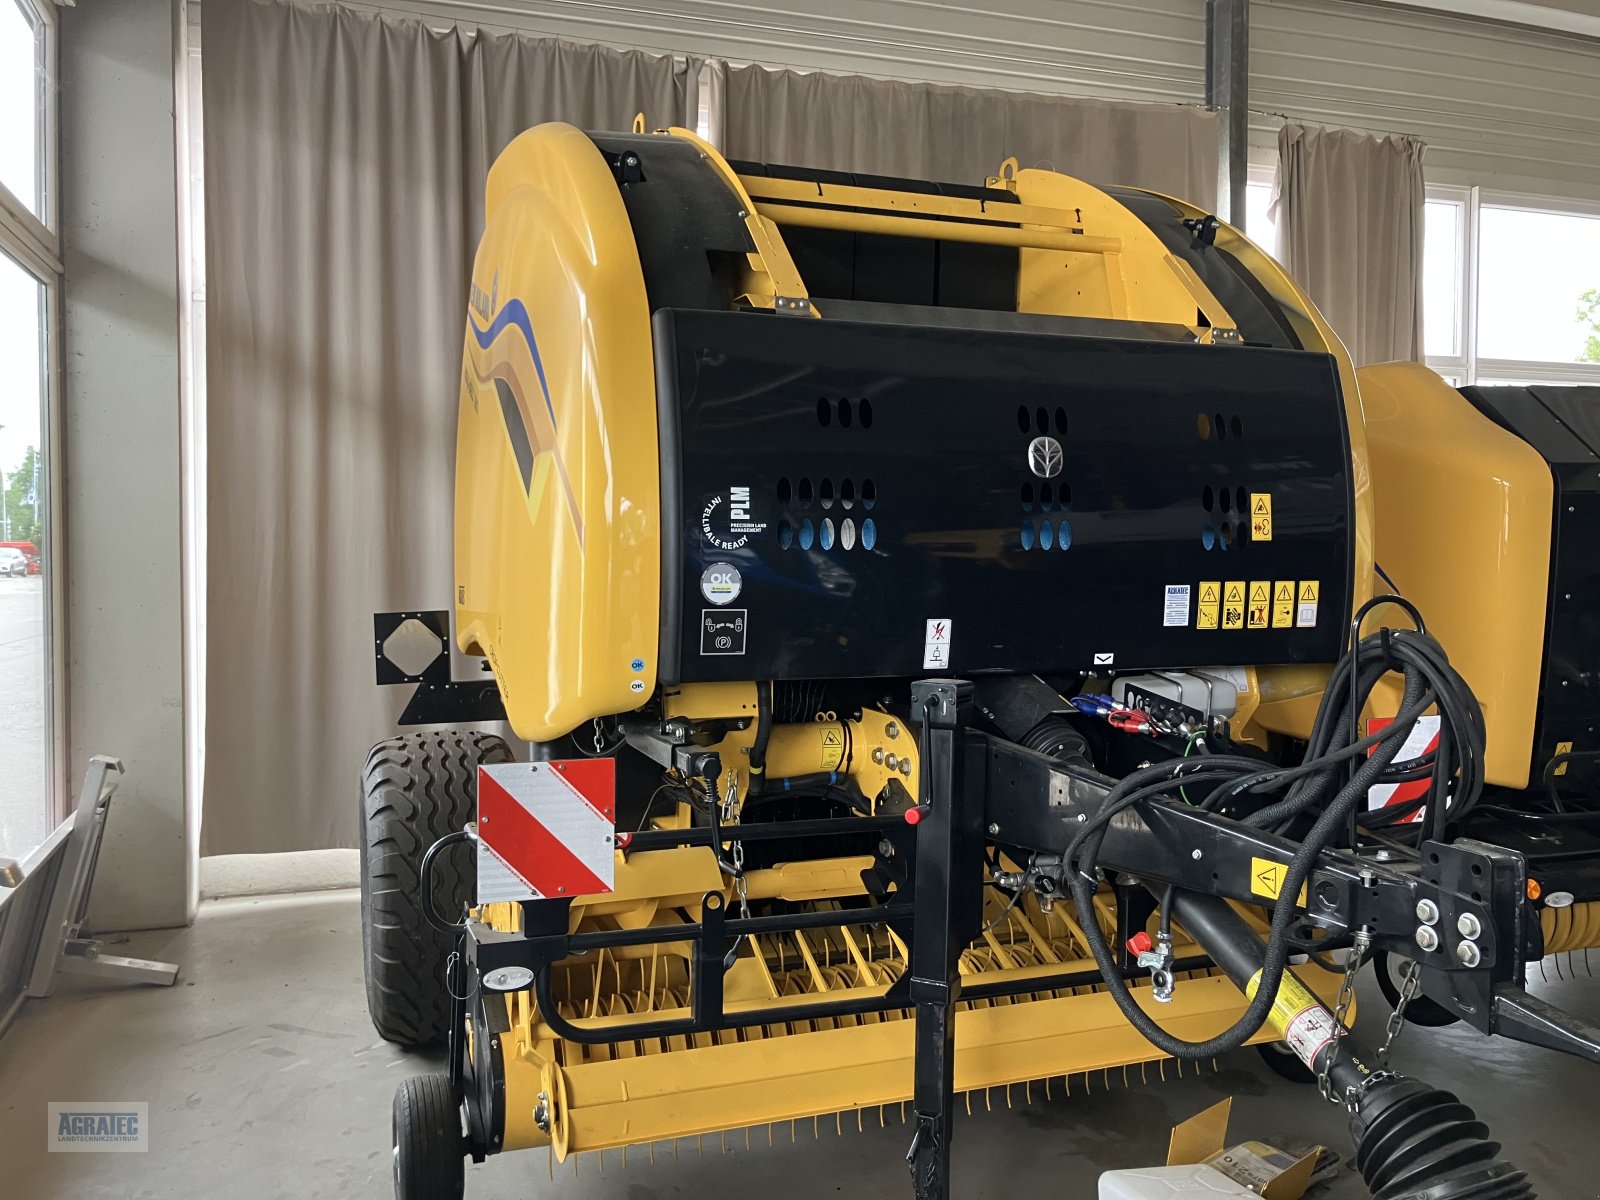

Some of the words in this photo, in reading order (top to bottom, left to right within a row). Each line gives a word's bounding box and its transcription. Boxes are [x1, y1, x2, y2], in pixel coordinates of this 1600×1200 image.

[731, 487, 750, 520] PLM
[702, 496, 722, 547] INTELLIBALE
[722, 534, 748, 550] READY
[711, 573, 732, 585] OK
